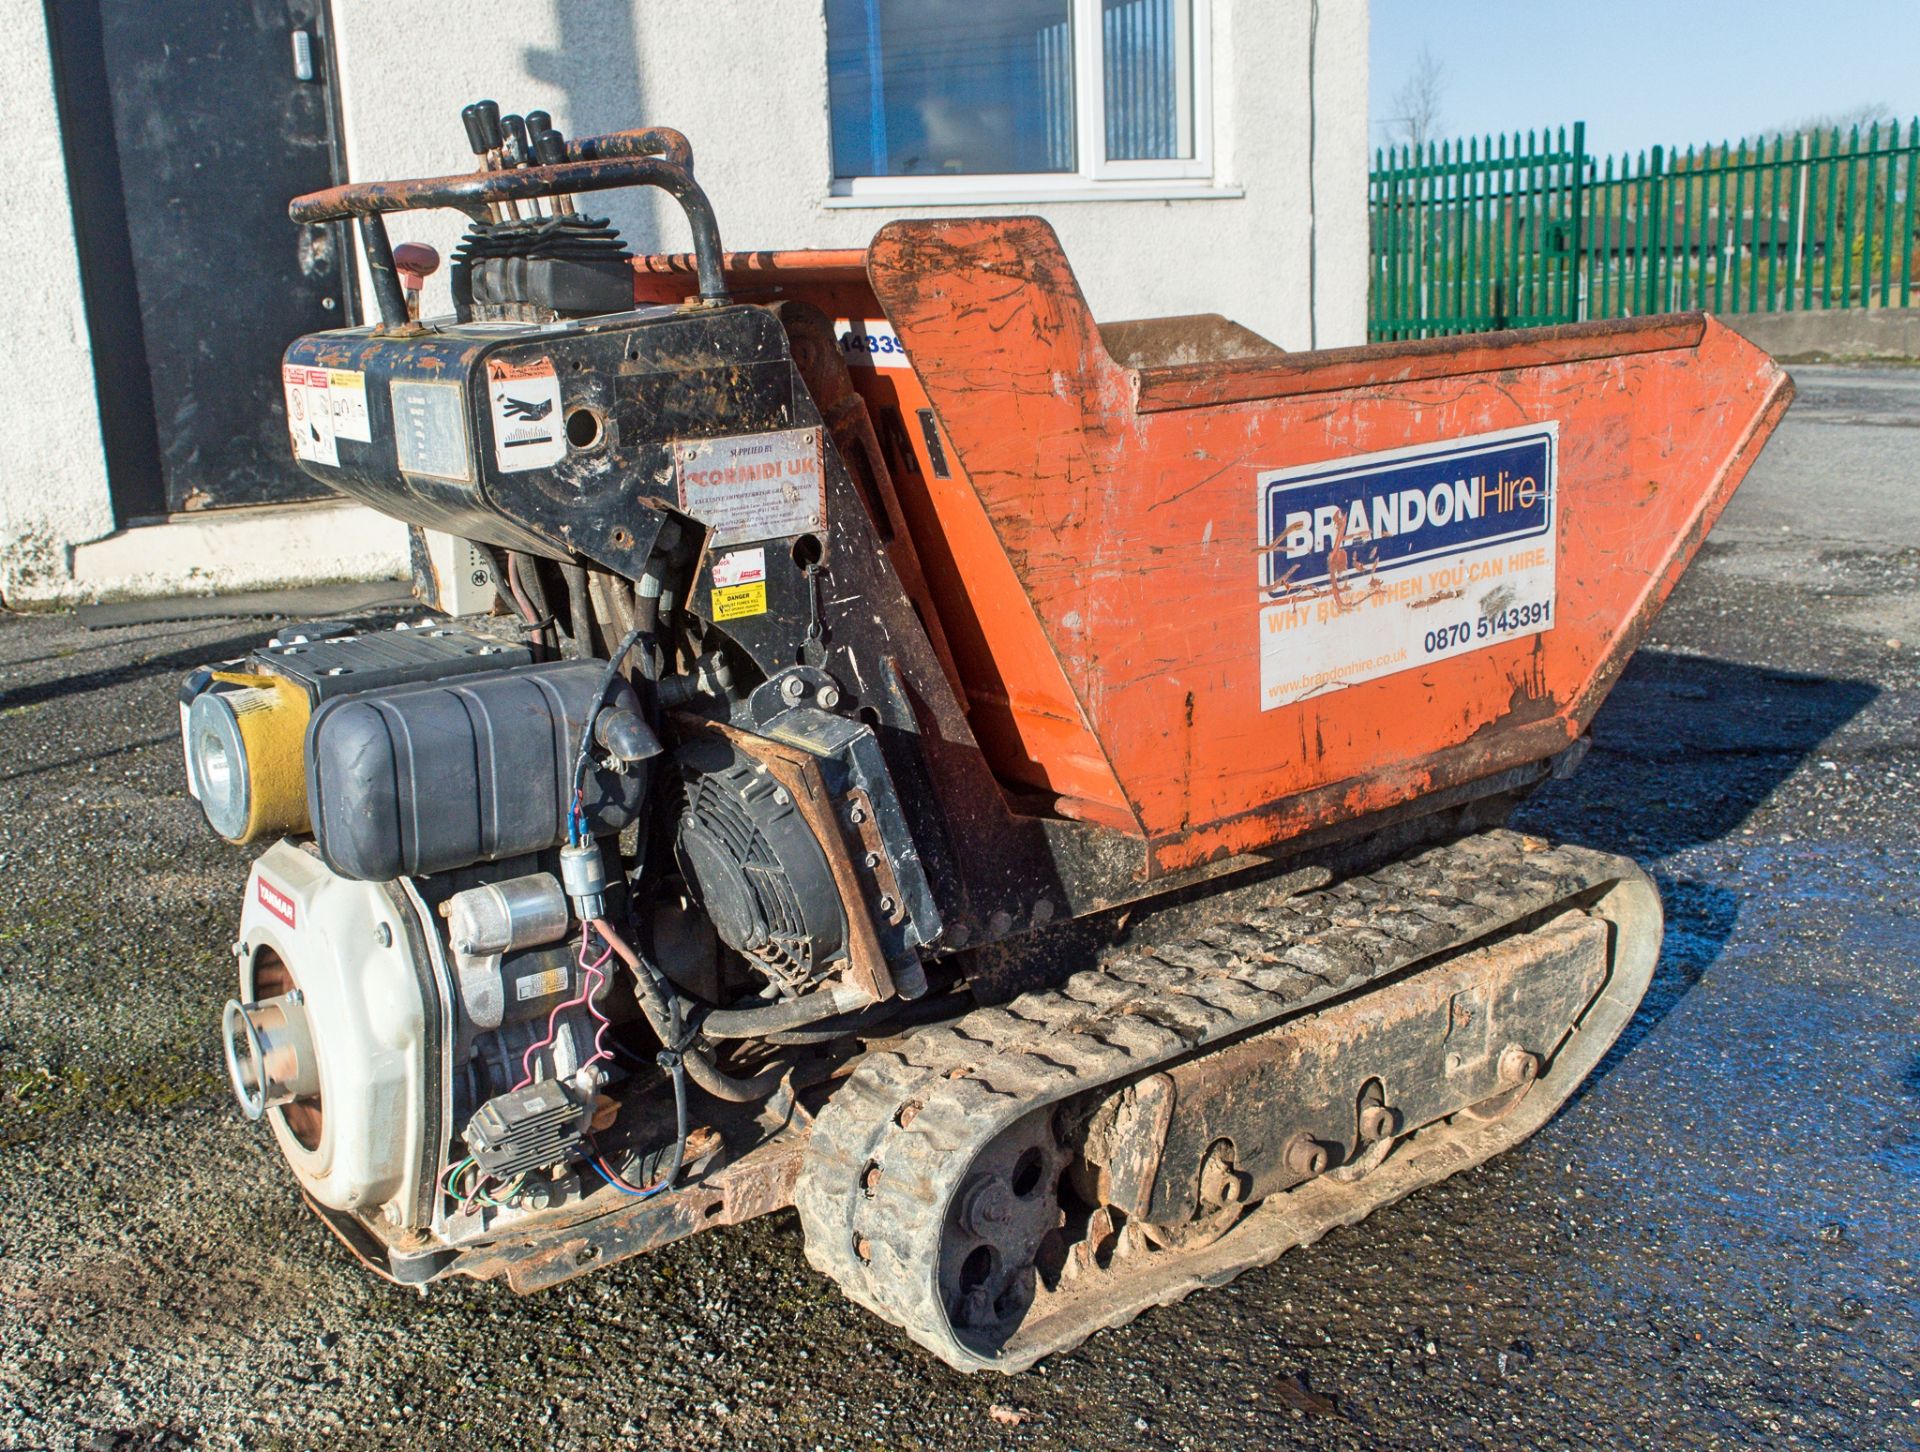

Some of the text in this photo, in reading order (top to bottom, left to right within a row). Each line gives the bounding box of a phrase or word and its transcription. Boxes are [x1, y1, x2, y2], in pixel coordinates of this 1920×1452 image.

[787, 458, 815, 476] UK
[1285, 471, 1536, 559] BRANDONHire
[727, 593, 750, 601] DANGER
[1268, 605, 1312, 634] WHY
[1370, 576, 1423, 609] WHEN
[1429, 566, 1465, 590] YOU
[1469, 558, 1503, 580] CAN
[1508, 547, 1550, 573] HIRE.
[1425, 600, 1551, 653] 0870 5143391
[1268, 648, 1408, 699] www.brandonhire.co.uk
[260, 884, 293, 920] YANMAR
